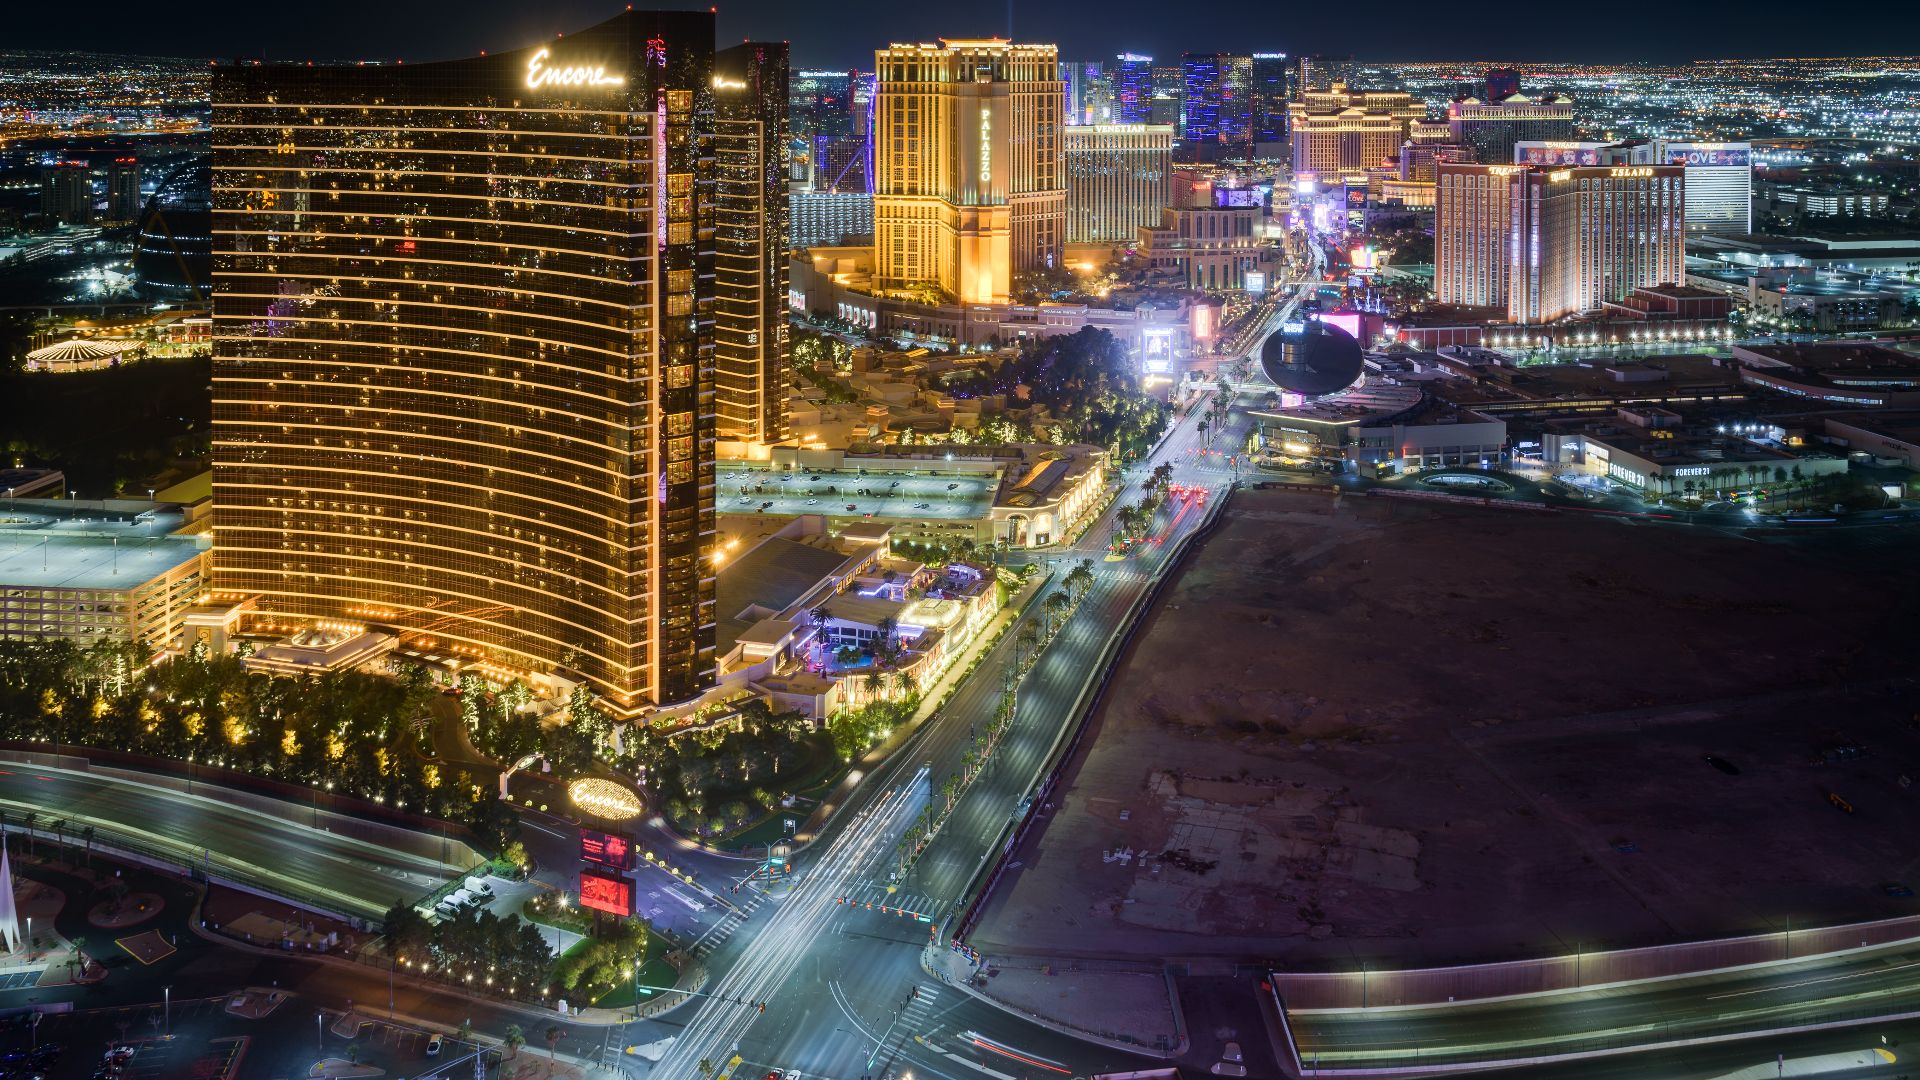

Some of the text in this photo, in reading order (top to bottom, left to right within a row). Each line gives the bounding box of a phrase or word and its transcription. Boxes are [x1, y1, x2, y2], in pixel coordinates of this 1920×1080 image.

[527, 49, 624, 88] Encore
[1095, 124, 1145, 133] VENETIAN
[981, 109, 991, 181] PALAZZO
[1683, 152, 1717, 164] LOVE
[1611, 168, 1654, 177] ISLAND
[1609, 463, 1646, 487] FOREVER 21
[1675, 467, 1710, 477] FOREVER 21
[574, 783, 641, 813] Encore
